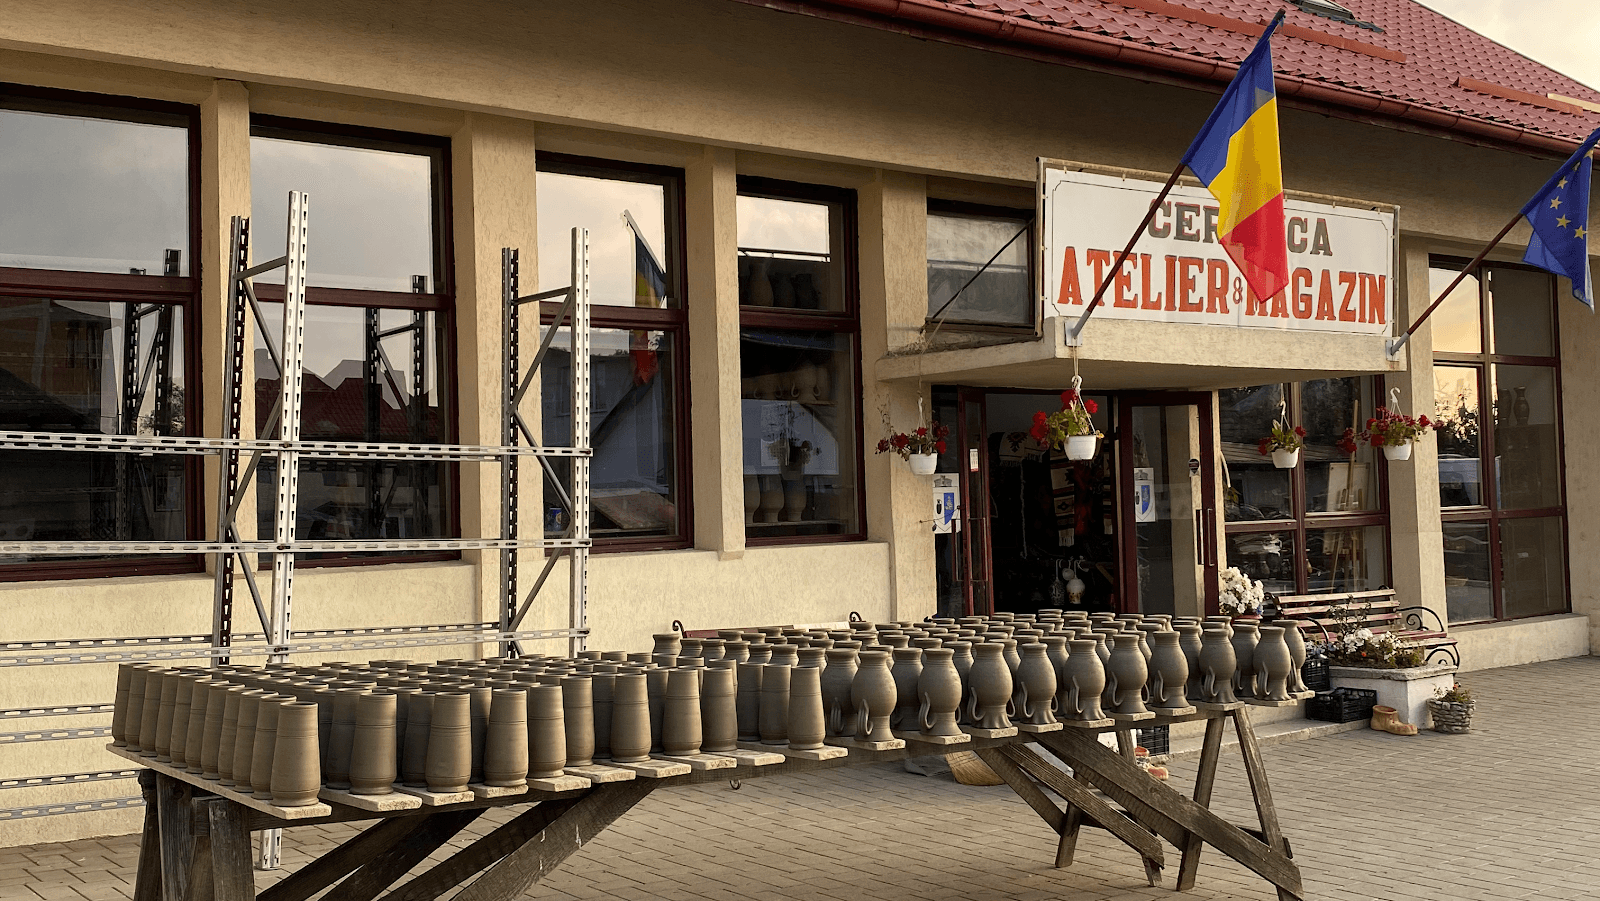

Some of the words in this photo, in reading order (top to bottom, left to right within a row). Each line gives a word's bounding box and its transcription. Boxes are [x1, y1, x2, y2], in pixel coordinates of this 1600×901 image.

[1148, 199, 1333, 256] CERCA
[1057, 245, 1230, 314] ATELIER
[1232, 276, 1244, 305] &
